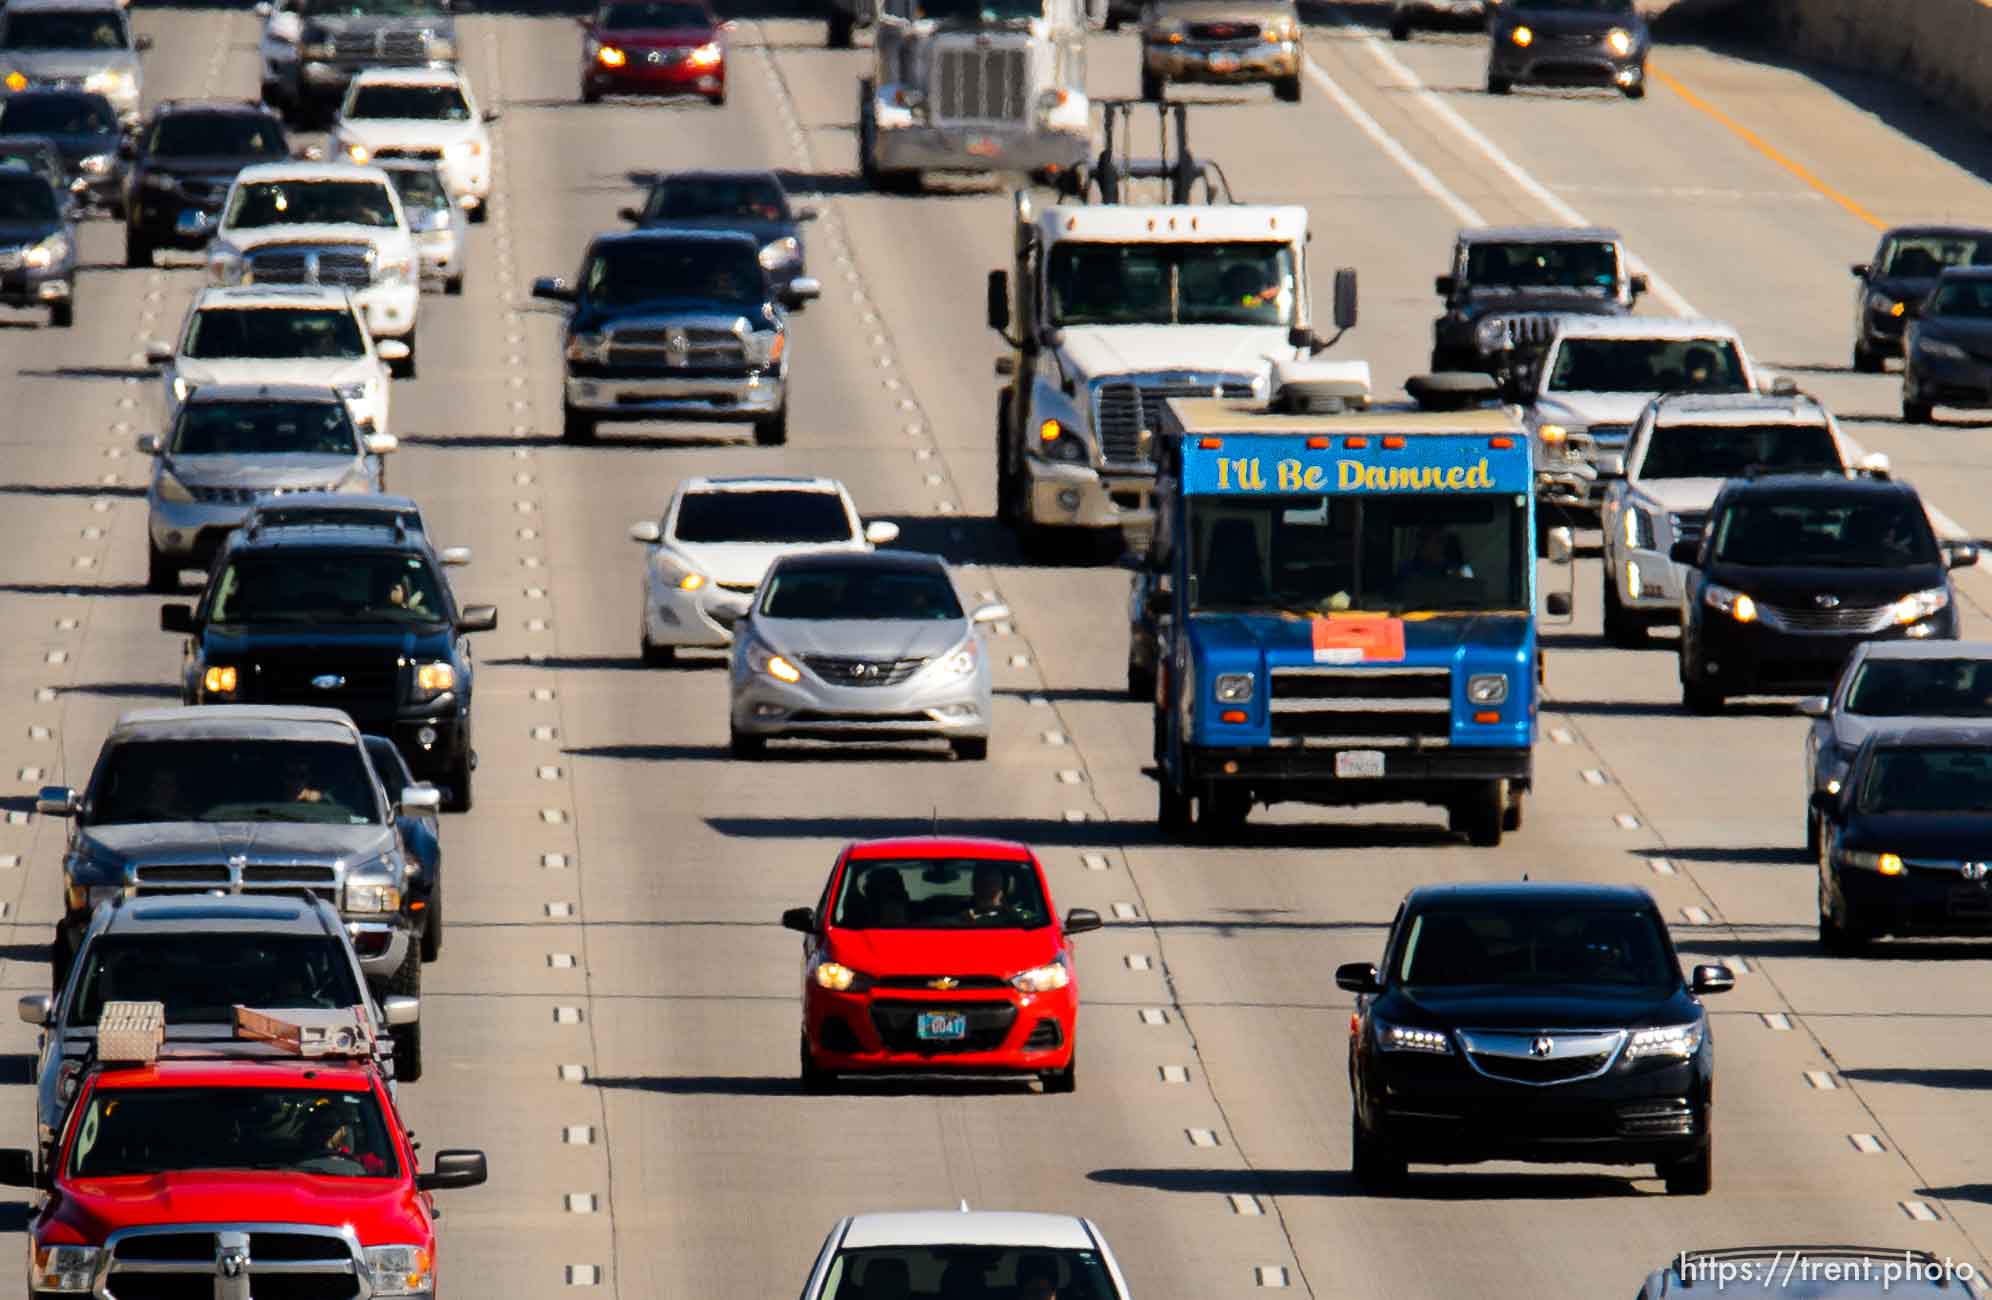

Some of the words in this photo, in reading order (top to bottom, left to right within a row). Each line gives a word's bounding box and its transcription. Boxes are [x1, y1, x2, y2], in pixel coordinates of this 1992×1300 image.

[1216, 457, 1266, 490] I'll
[1277, 457, 1328, 490] Be
[1336, 457, 1496, 490] Damned
